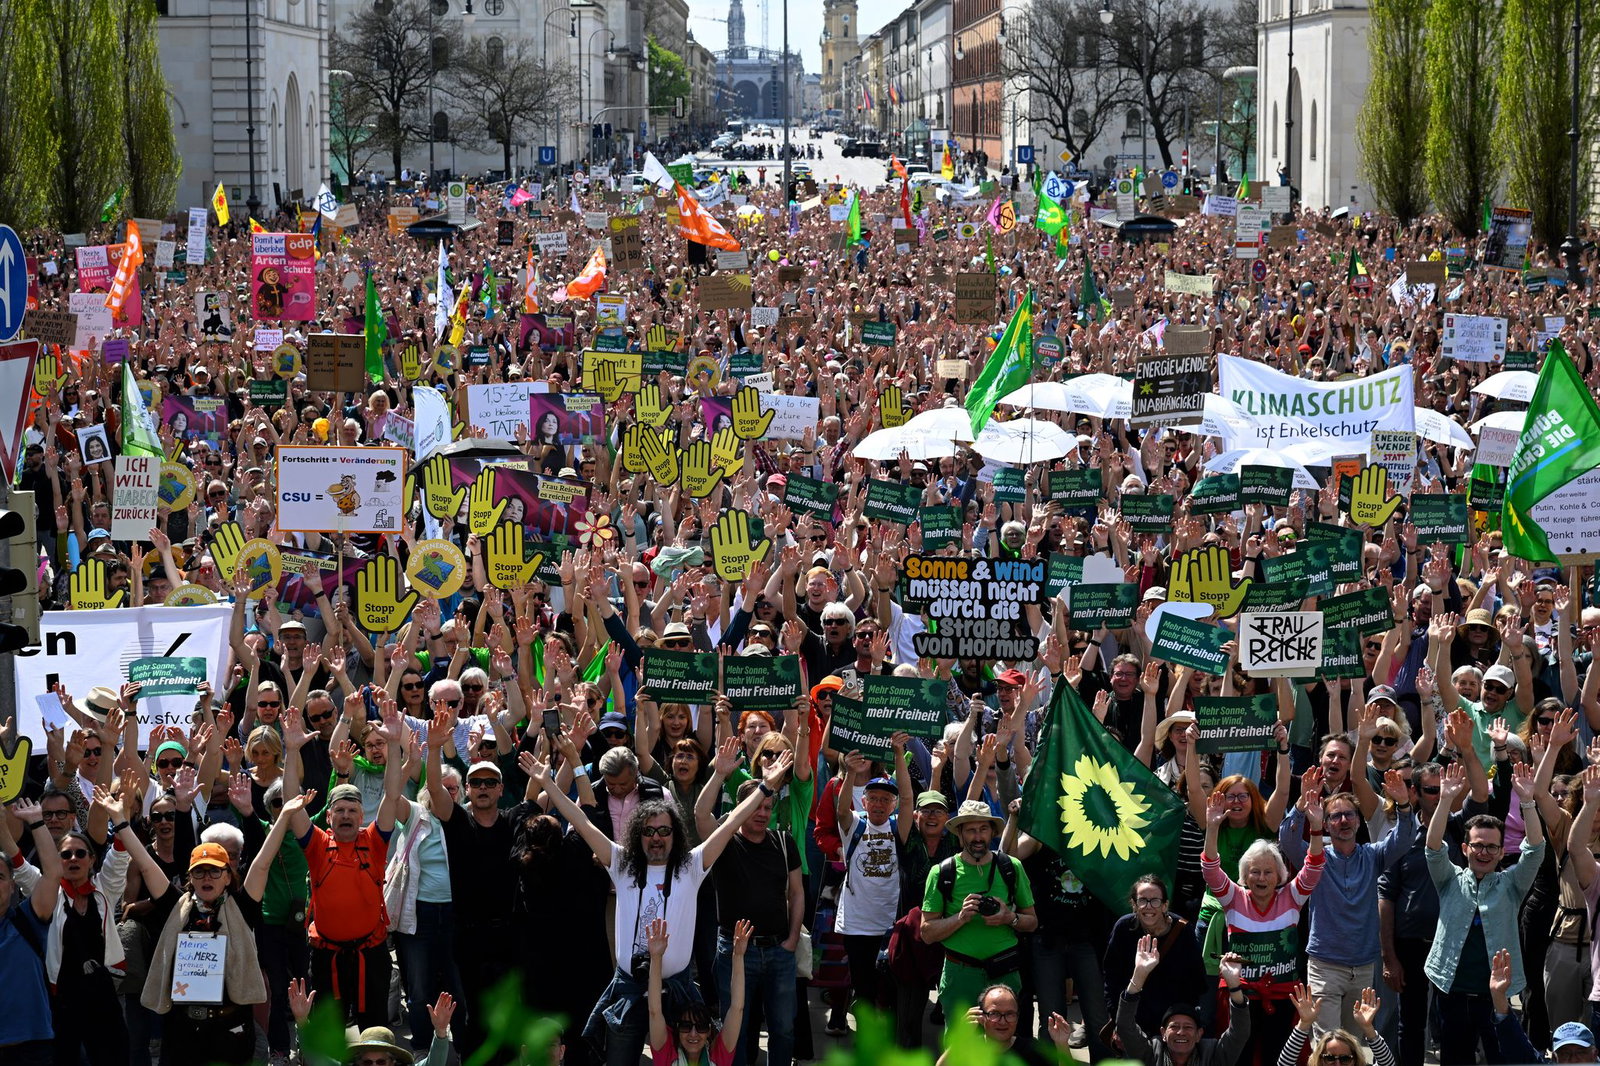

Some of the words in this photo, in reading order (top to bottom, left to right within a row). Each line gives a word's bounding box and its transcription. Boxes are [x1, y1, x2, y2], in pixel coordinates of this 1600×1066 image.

[542, 149, 552, 161] U
[1021, 149, 1031, 161] U
[254, 236, 272, 245] Damit
[272, 238, 285, 246] wir
[289, 238, 313, 251] ödp
[255, 256, 286, 265] Arten
[80, 268, 110, 278] Klima
[283, 265, 312, 274] Schutz
[591, 357, 627, 368] Zunft
[748, 376, 768, 385] OMAS
[1232, 375, 1402, 417] KLIMASCHUTZ
[787, 399, 796, 407] to
[738, 418, 760, 428] Stopp
[773, 424, 787, 432] mit
[1256, 425, 1276, 438] ist
[1280, 419, 1379, 439] Enkelschutz
[1375, 434, 1414, 443] ENERGIE-
[1482, 431, 1519, 444] DEMOKRAT
[1376, 442, 1411, 451] WENDE
[282, 455, 331, 463] Fortschritt
[340, 456, 396, 466] Veränderung
[713, 454, 733, 466] Stopp
[1383, 453, 1406, 461] STATT
[126, 458, 148, 472] ICH
[655, 457, 671, 472] Stopp
[660, 467, 673, 480] Gas!
[116, 475, 152, 487] WILL
[686, 475, 707, 485] Stopp
[541, 483, 559, 491] Frau
[560, 486, 584, 496] Reiche,
[687, 483, 703, 491] Gas!
[113, 490, 157, 506] HABECK
[282, 492, 311, 502] CSU
[431, 493, 452, 505] Stopp
[548, 493, 571, 502] reicht!
[1570, 490, 1588, 498] weiter
[434, 503, 449, 512] Gas!
[1357, 502, 1383, 511] Stopp
[1535, 503, 1556, 512] Putin,
[1559, 503, 1580, 511] Kohle
[114, 508, 156, 520] ZURÜCK!
[473, 510, 492, 520] Stopp
[1357, 510, 1377, 519] Gas!
[1535, 515, 1550, 523] und
[1553, 515, 1576, 525] Kriege
[1580, 513, 1600, 523] führe
[474, 519, 487, 528] Gas!
[1546, 530, 1574, 540] Denkt
[410, 541, 455, 568] SOLARENERGIE
[721, 554, 750, 565] Stopp
[282, 555, 306, 565] Schluss
[308, 558, 319, 566] mit
[320, 561, 336, 570] dem
[494, 562, 523, 574] Stopp
[724, 564, 745, 574] Gas!
[907, 557, 968, 580] Sonne
[972, 561, 991, 579] &
[994, 561, 1044, 582] Wind
[497, 572, 517, 581] Gas!
[910, 579, 982, 600] müssen
[988, 581, 1040, 602] nicht
[1074, 591, 1091, 600] Mehr
[1091, 591, 1112, 601] Sonne,
[1200, 591, 1230, 603] Stopp
[77, 600, 104, 609] Stopp
[365, 603, 395, 615] Stopp
[930, 598, 986, 619] durch
[991, 600, 1019, 619] die
[1074, 599, 1089, 608] mehr
[1089, 599, 1109, 608] Wind,
[1073, 608, 1094, 619] mehr
[1096, 607, 1132, 618] Freiheit!
[367, 614, 389, 624] Gas!
[940, 617, 1011, 639] Straße
[1163, 620, 1182, 633] Mehr
[1182, 625, 1205, 639] Sonne,
[1254, 616, 1303, 635] FRAU
[1161, 629, 1179, 641] mehr
[1180, 633, 1200, 646] Wind,
[916, 637, 953, 656] von
[1158, 638, 1183, 652] mehr
[1184, 644, 1224, 664] Freiheit!
[726, 665, 743, 675] Mehr
[744, 665, 769, 676] Sonne,
[159, 675, 202, 685] Freiheit!
[672, 678, 713, 691] Freiheit!
[726, 675, 744, 684] mehr
[745, 674, 767, 685] Wind,
[726, 687, 752, 697] mehr
[753, 684, 796, 697] Freiheit!
[868, 685, 888, 696] Mehr
[889, 685, 916, 698] Sonne,
[867, 696, 887, 706] mehr
[888, 696, 911, 708] Wind,
[867, 707, 893, 720] mehr
[895, 708, 940, 722] Freiheit!
[1199, 706, 1219, 715] Mehr
[1219, 705, 1247, 716] Sonne,
[1199, 717, 1220, 726] mehr
[1221, 716, 1244, 726] Wind,
[1200, 727, 1228, 739] mehr
[1229, 725, 1274, 738] Freiheit!
[179, 940, 208, 950] Meine
[177, 962, 204, 972] grenze
[1259, 957, 1296, 977] Freiheit!
[182, 968, 208, 978] erreicht
